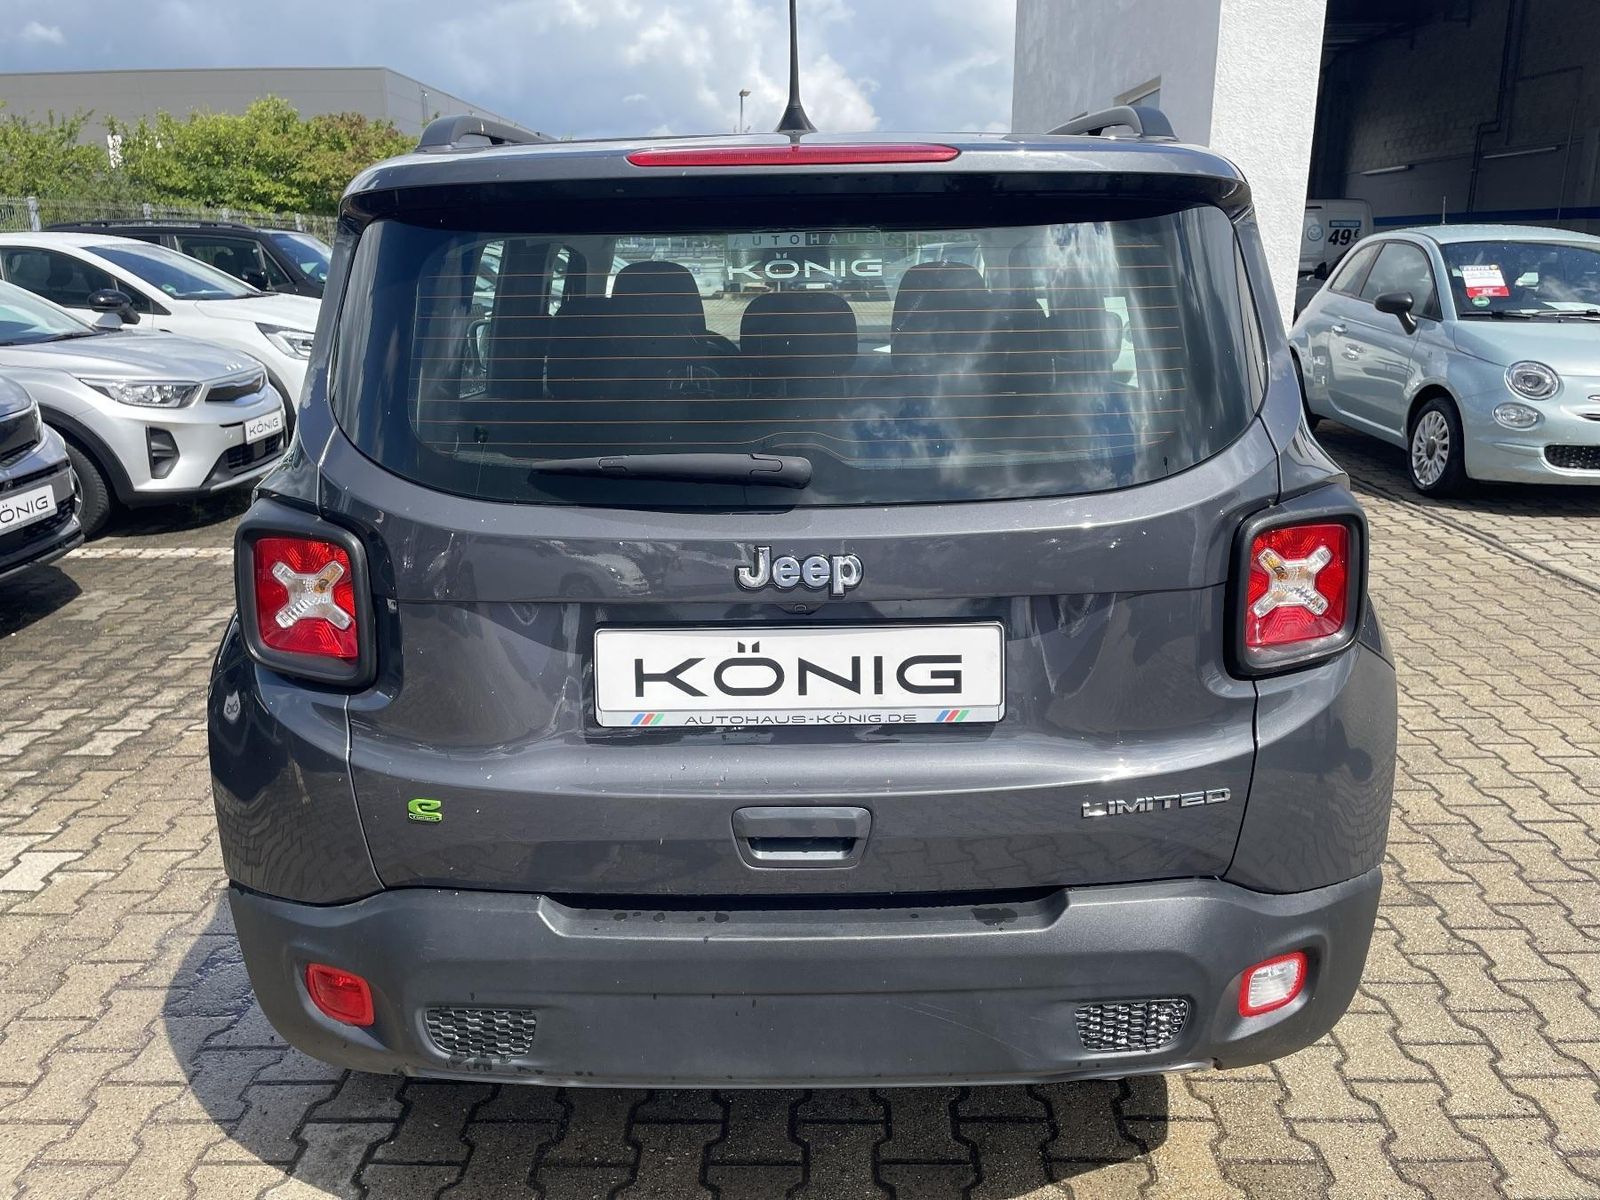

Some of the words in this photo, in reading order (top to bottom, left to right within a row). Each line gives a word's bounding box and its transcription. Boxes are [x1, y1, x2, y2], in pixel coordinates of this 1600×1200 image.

[727, 252, 883, 280] KÖNIG
[735, 545, 864, 597] Jeep
[634, 640, 963, 698] KÖNIG
[684, 711, 917, 726] AUTOHAUS-KÖNIG.DE
[1082, 788, 1231, 818] LIMITED
